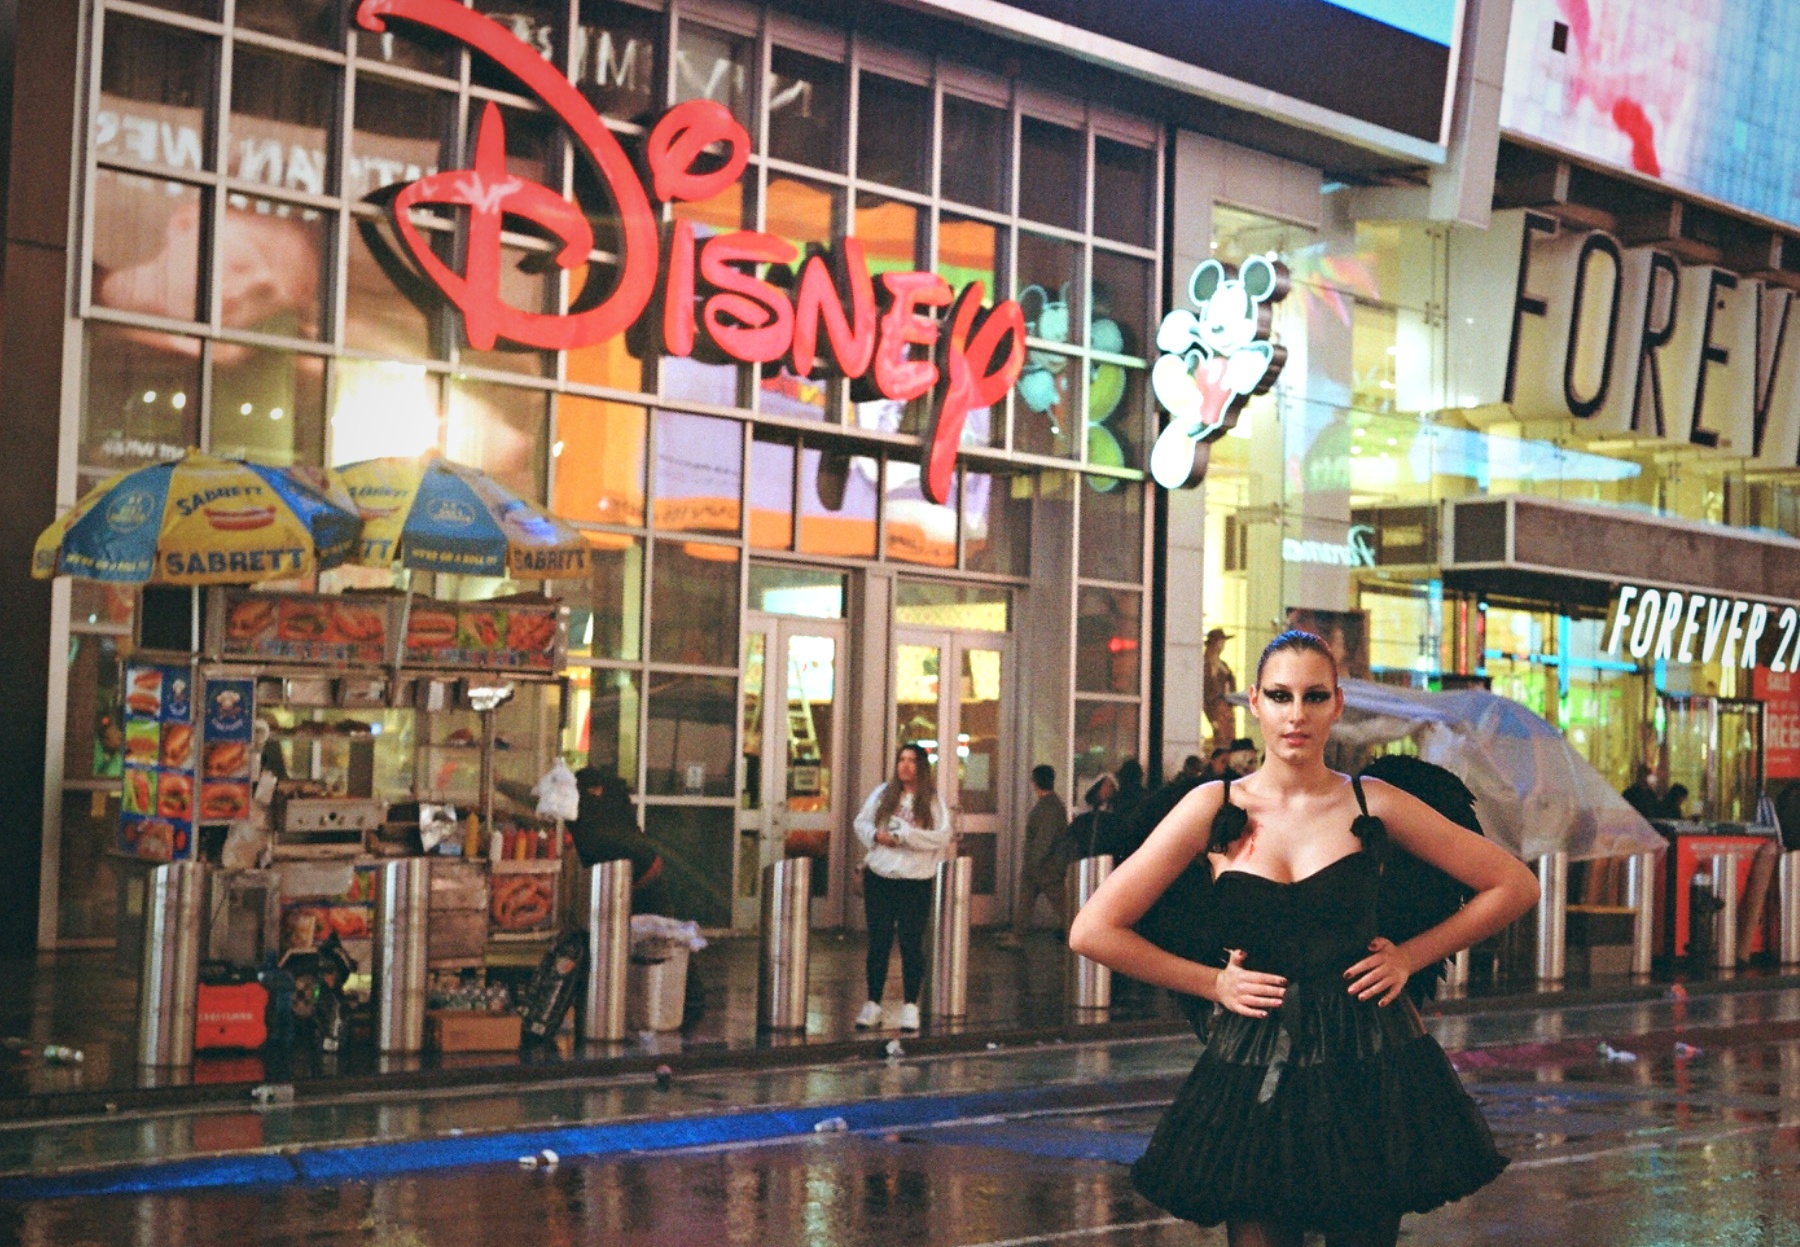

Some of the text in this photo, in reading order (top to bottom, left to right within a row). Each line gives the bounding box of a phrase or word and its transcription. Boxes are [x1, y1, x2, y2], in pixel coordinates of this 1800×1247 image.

[1503, 211, 1800, 465] FOREV
[177, 485, 263, 516] SABRETT
[166, 547, 305, 575] SABRETT
[1608, 586, 1767, 670] FOREVER
